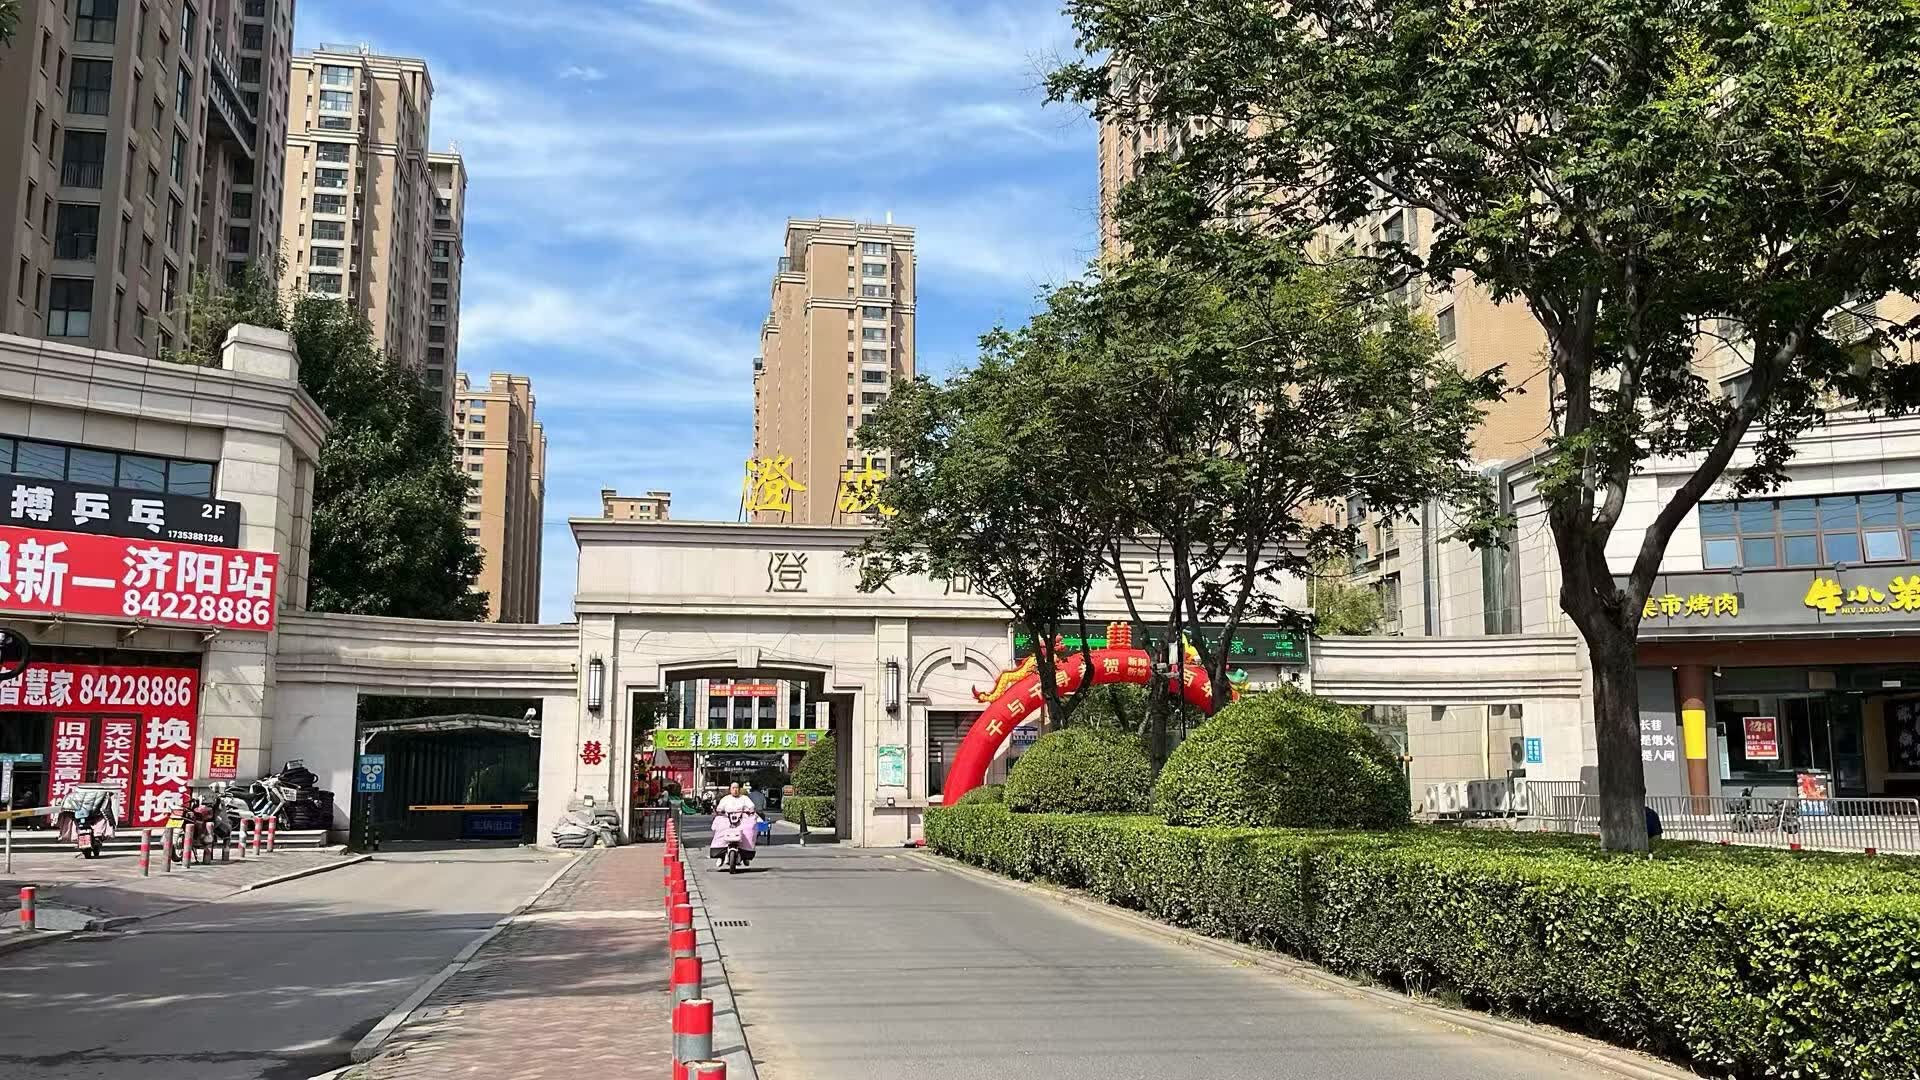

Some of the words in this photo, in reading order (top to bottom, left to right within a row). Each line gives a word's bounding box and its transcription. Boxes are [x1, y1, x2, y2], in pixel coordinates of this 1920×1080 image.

[201, 503, 226, 519] 2F
[167, 530, 224, 543] 17353881284
[122, 589, 270, 625] 84228886
[79, 673, 191, 706] 84228886
[212, 739, 236, 768] 出租
